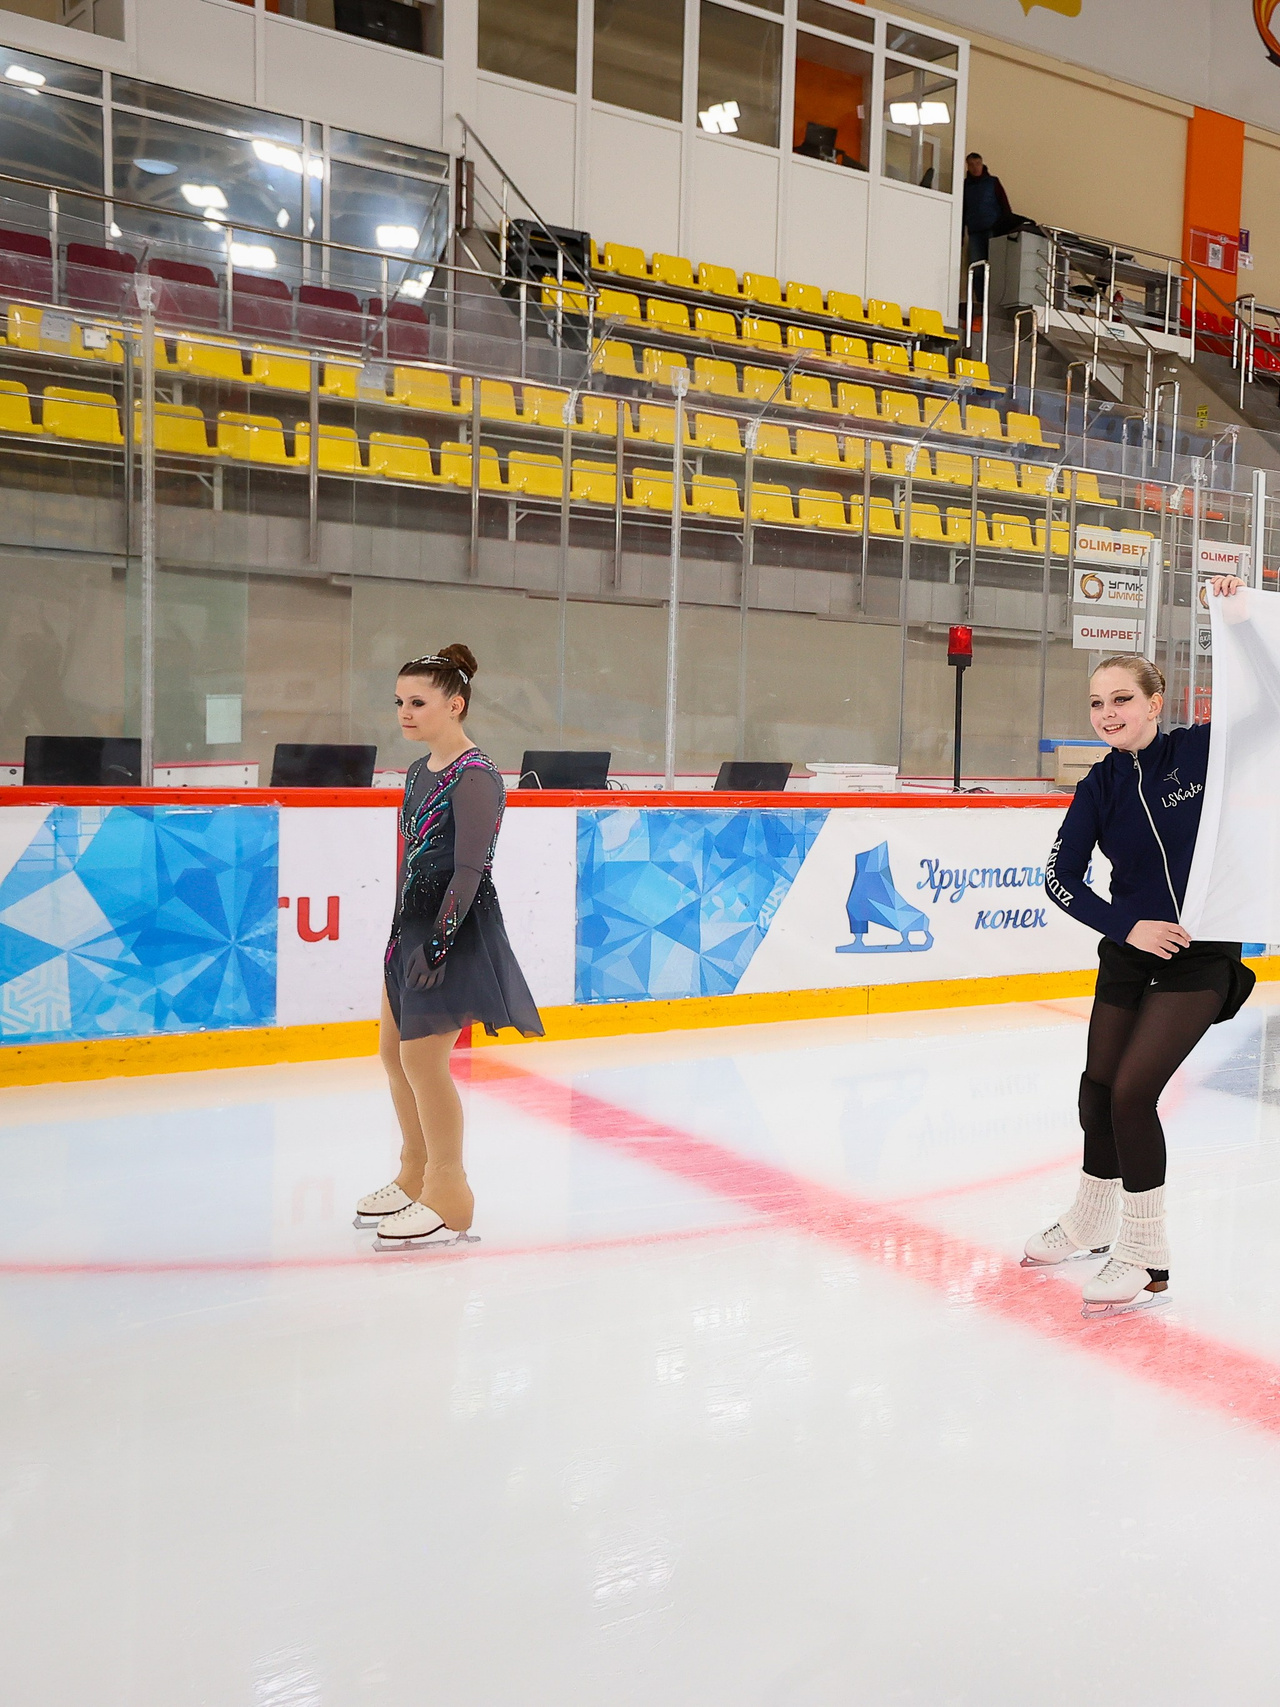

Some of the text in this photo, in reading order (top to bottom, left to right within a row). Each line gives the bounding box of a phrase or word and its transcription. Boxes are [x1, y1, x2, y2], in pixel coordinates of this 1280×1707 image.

[1078, 538, 1147, 556] OLIMPBET
[1201, 551, 1240, 564] OLIMPB
[1108, 580, 1144, 592] УГМК
[1108, 591, 1144, 602] UMMC
[1080, 627, 1142, 641] OLIMPBET
[1161, 782, 1203, 809] LSKate
[974, 908, 1048, 930] конек
